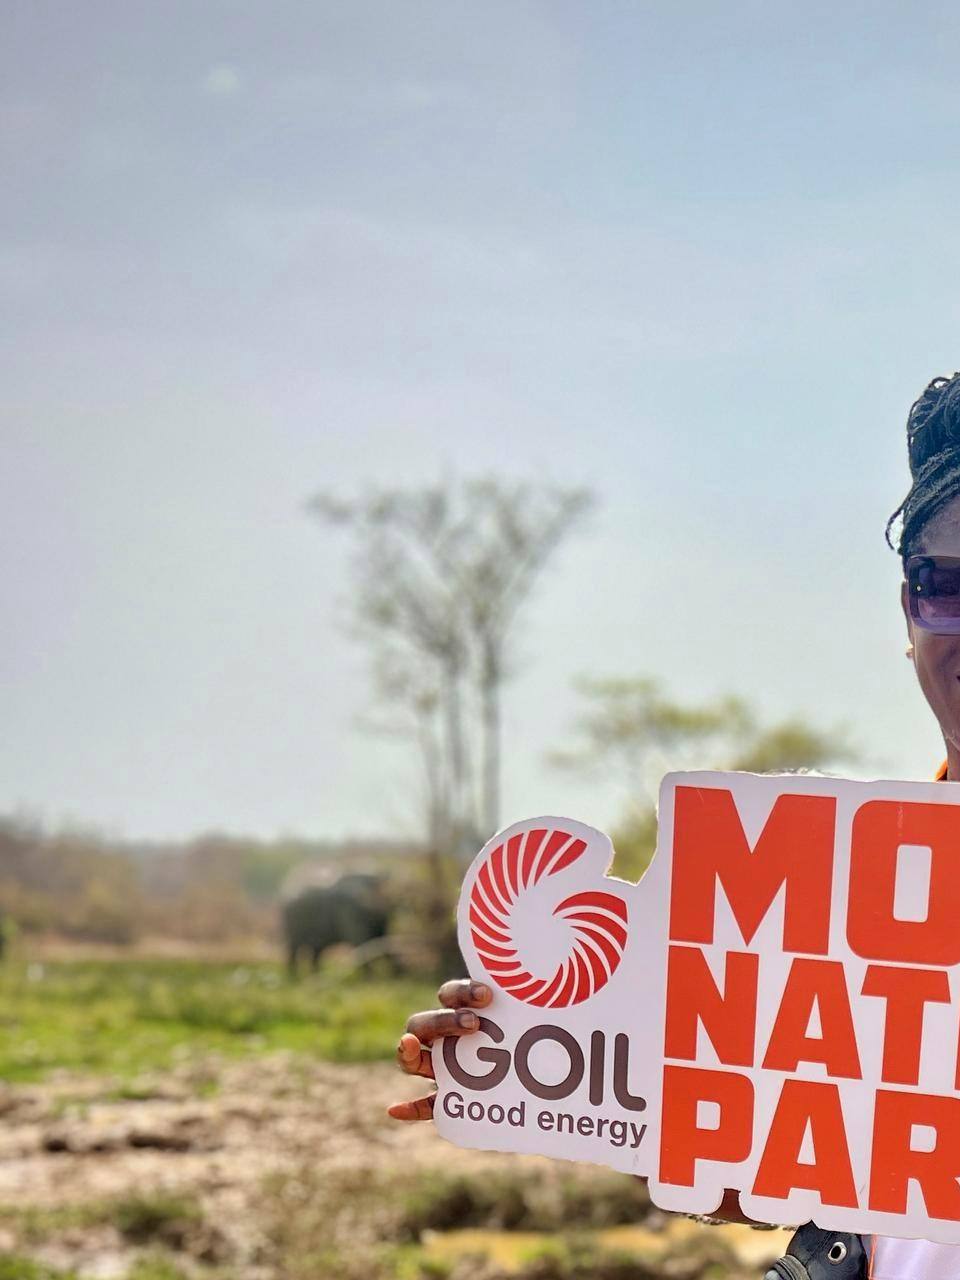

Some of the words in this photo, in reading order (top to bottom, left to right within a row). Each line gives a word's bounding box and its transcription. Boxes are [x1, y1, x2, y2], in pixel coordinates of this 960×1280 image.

[442, 1014, 648, 1112] GOIL
[442, 1091, 526, 1128] Good
[537, 1110, 648, 1149] energy
